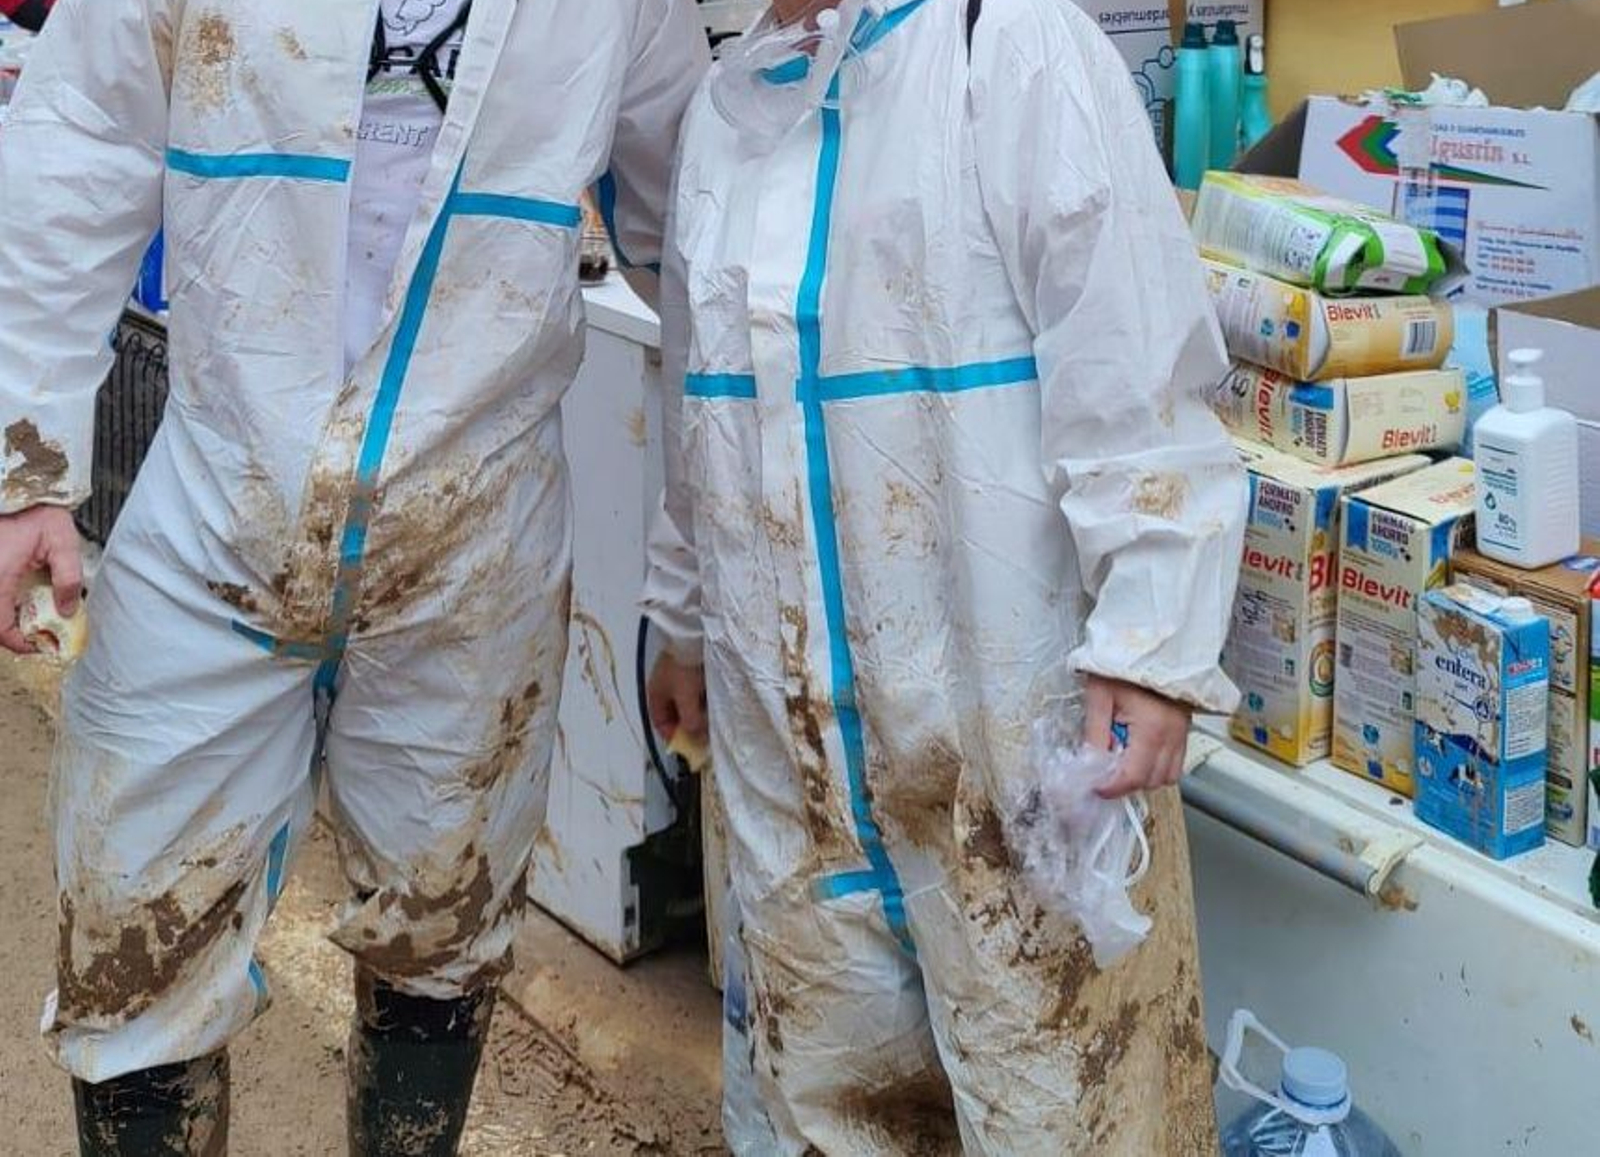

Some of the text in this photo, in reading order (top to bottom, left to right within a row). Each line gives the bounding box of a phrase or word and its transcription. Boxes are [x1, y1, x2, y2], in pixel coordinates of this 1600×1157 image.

[1260, 481, 1301, 505] FORMATO
[1242, 545, 1295, 581] levit
[1342, 567, 1411, 608] Blevit
[1435, 655, 1486, 690] entera
